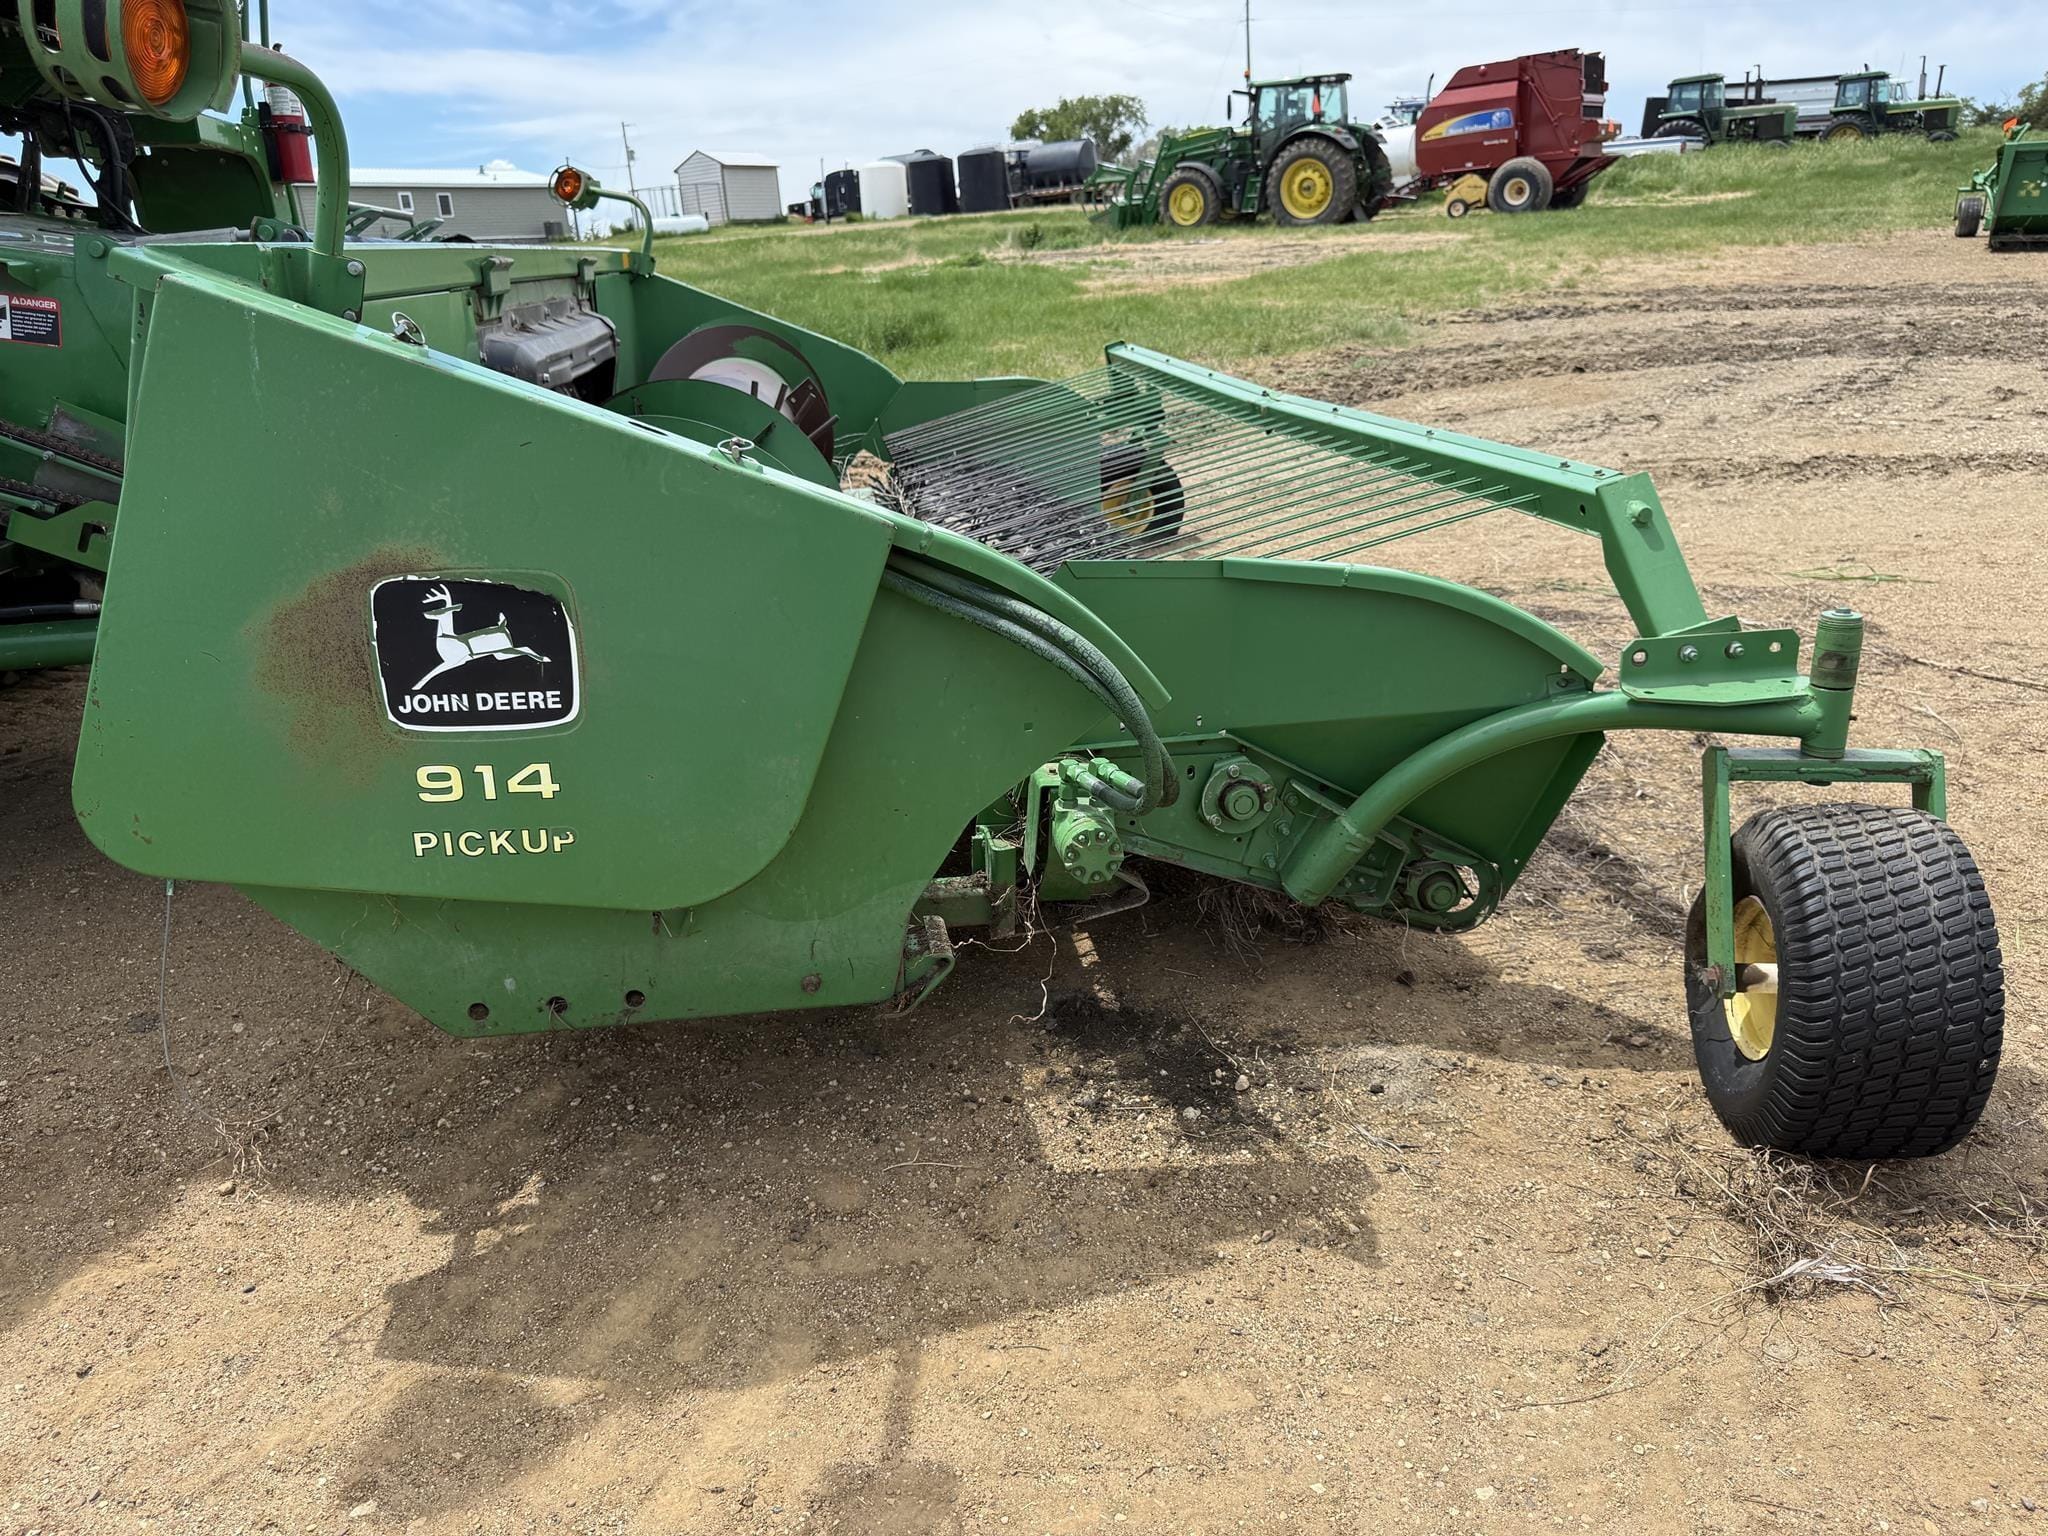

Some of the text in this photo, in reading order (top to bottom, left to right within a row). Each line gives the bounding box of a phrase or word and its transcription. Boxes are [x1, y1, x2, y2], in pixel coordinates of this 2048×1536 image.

[20, 298, 57, 309] DANGER
[398, 691, 562, 714] JOHN DEERE
[415, 763, 561, 803] 914
[412, 829, 575, 857] PICKUP
